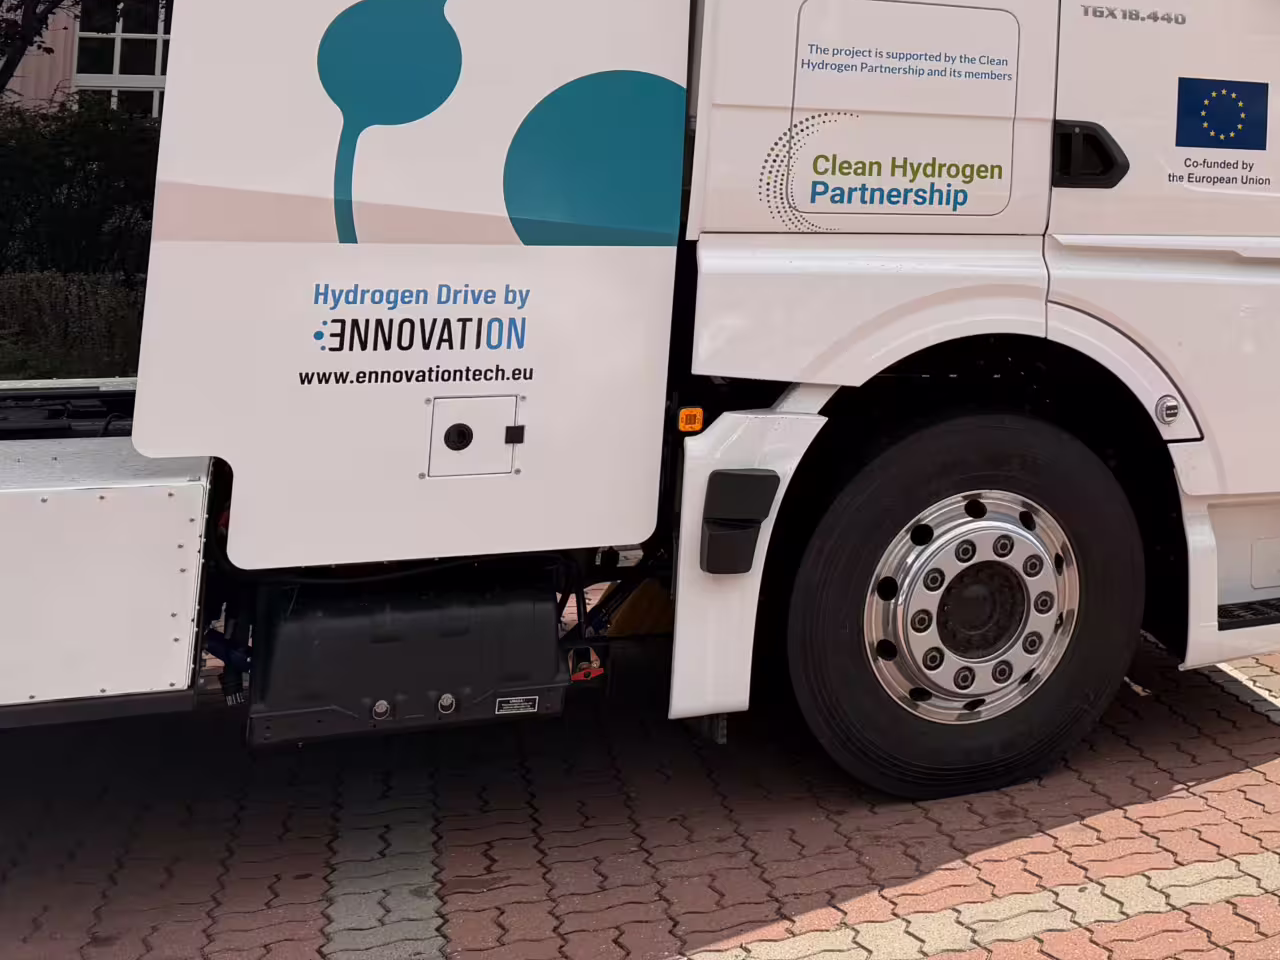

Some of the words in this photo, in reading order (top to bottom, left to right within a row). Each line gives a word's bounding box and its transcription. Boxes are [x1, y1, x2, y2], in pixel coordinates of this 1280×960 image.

[1080, 4, 1117, 20] TGX
[808, 43, 830, 56] The
[832, 45, 872, 60] project
[875, 47, 884, 58] is
[886, 49, 942, 64] supported
[944, 52, 957, 65] by
[959, 53, 977, 65] the
[978, 54, 1009, 67] Clean
[801, 58, 858, 74] Hydrogen
[860, 62, 926, 78] Partnership
[927, 65, 947, 77] and
[949, 66, 962, 78] its
[964, 68, 1013, 81] members
[812, 154, 882, 177] Clean
[890, 156, 1003, 183] Hydrogen
[1184, 158, 1239, 171] Co-funded
[1241, 160, 1254, 172] by
[1168, 173, 1184, 184] the
[1187, 173, 1239, 187] European
[1241, 175, 1271, 186] Union
[810, 180, 969, 212] Partnership
[313, 283, 429, 311] Hydrogen
[436, 283, 497, 305] Drive
[503, 283, 531, 310] by
[298, 364, 534, 385] www.ennovationtech.eu
